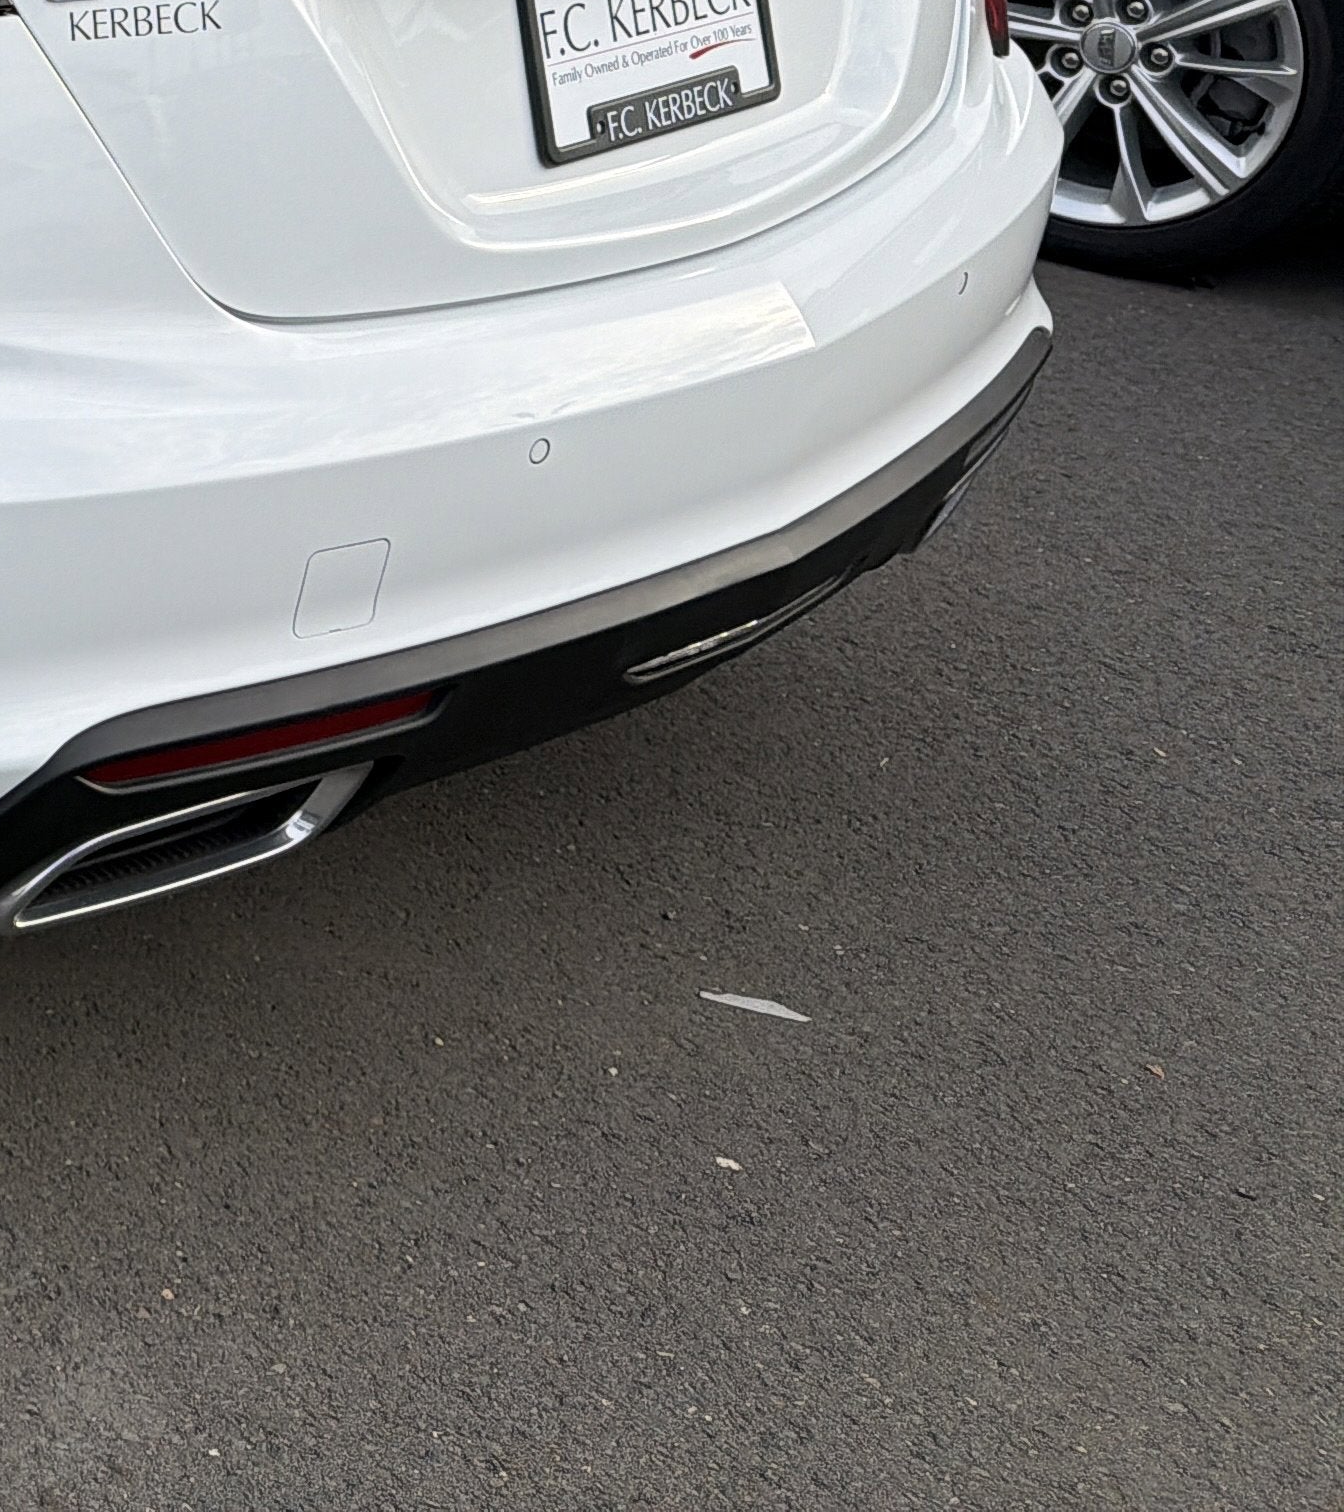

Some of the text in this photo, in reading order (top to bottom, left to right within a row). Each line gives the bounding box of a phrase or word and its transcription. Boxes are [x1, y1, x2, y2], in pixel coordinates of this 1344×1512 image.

[69, 0, 222, 41] KERBECK
[539, 3, 600, 59] F.C.
[552, 24, 752, 86] Family Owned & Operated For Over 100 Years
[606, 78, 733, 141] F.C. KERBECK
